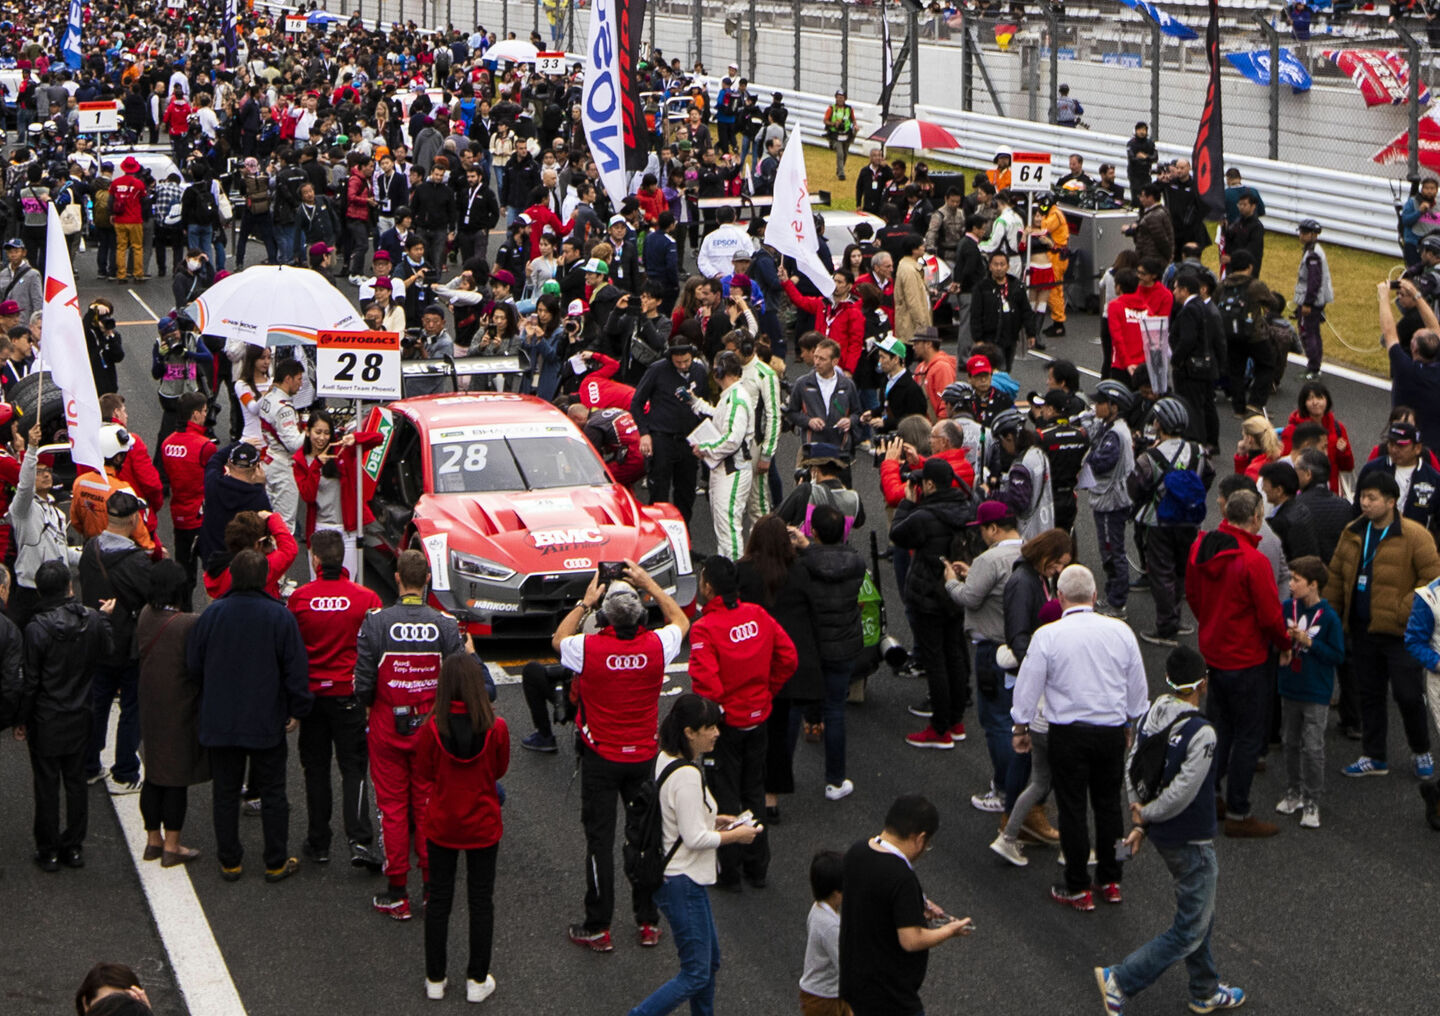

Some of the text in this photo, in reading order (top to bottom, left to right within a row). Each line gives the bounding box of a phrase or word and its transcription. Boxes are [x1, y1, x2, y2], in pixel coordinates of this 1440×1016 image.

[541, 59, 559, 69] 33
[95, 112, 101, 124] 1
[1020, 165, 1044, 182] 64
[713, 239, 738, 247] EPSON
[334, 336, 397, 345] AUTOBACS
[334, 353, 383, 382] 28
[439, 443, 488, 474] 28
[80, 492, 104, 503] OFFICIAL
[531, 528, 604, 548] BMC
